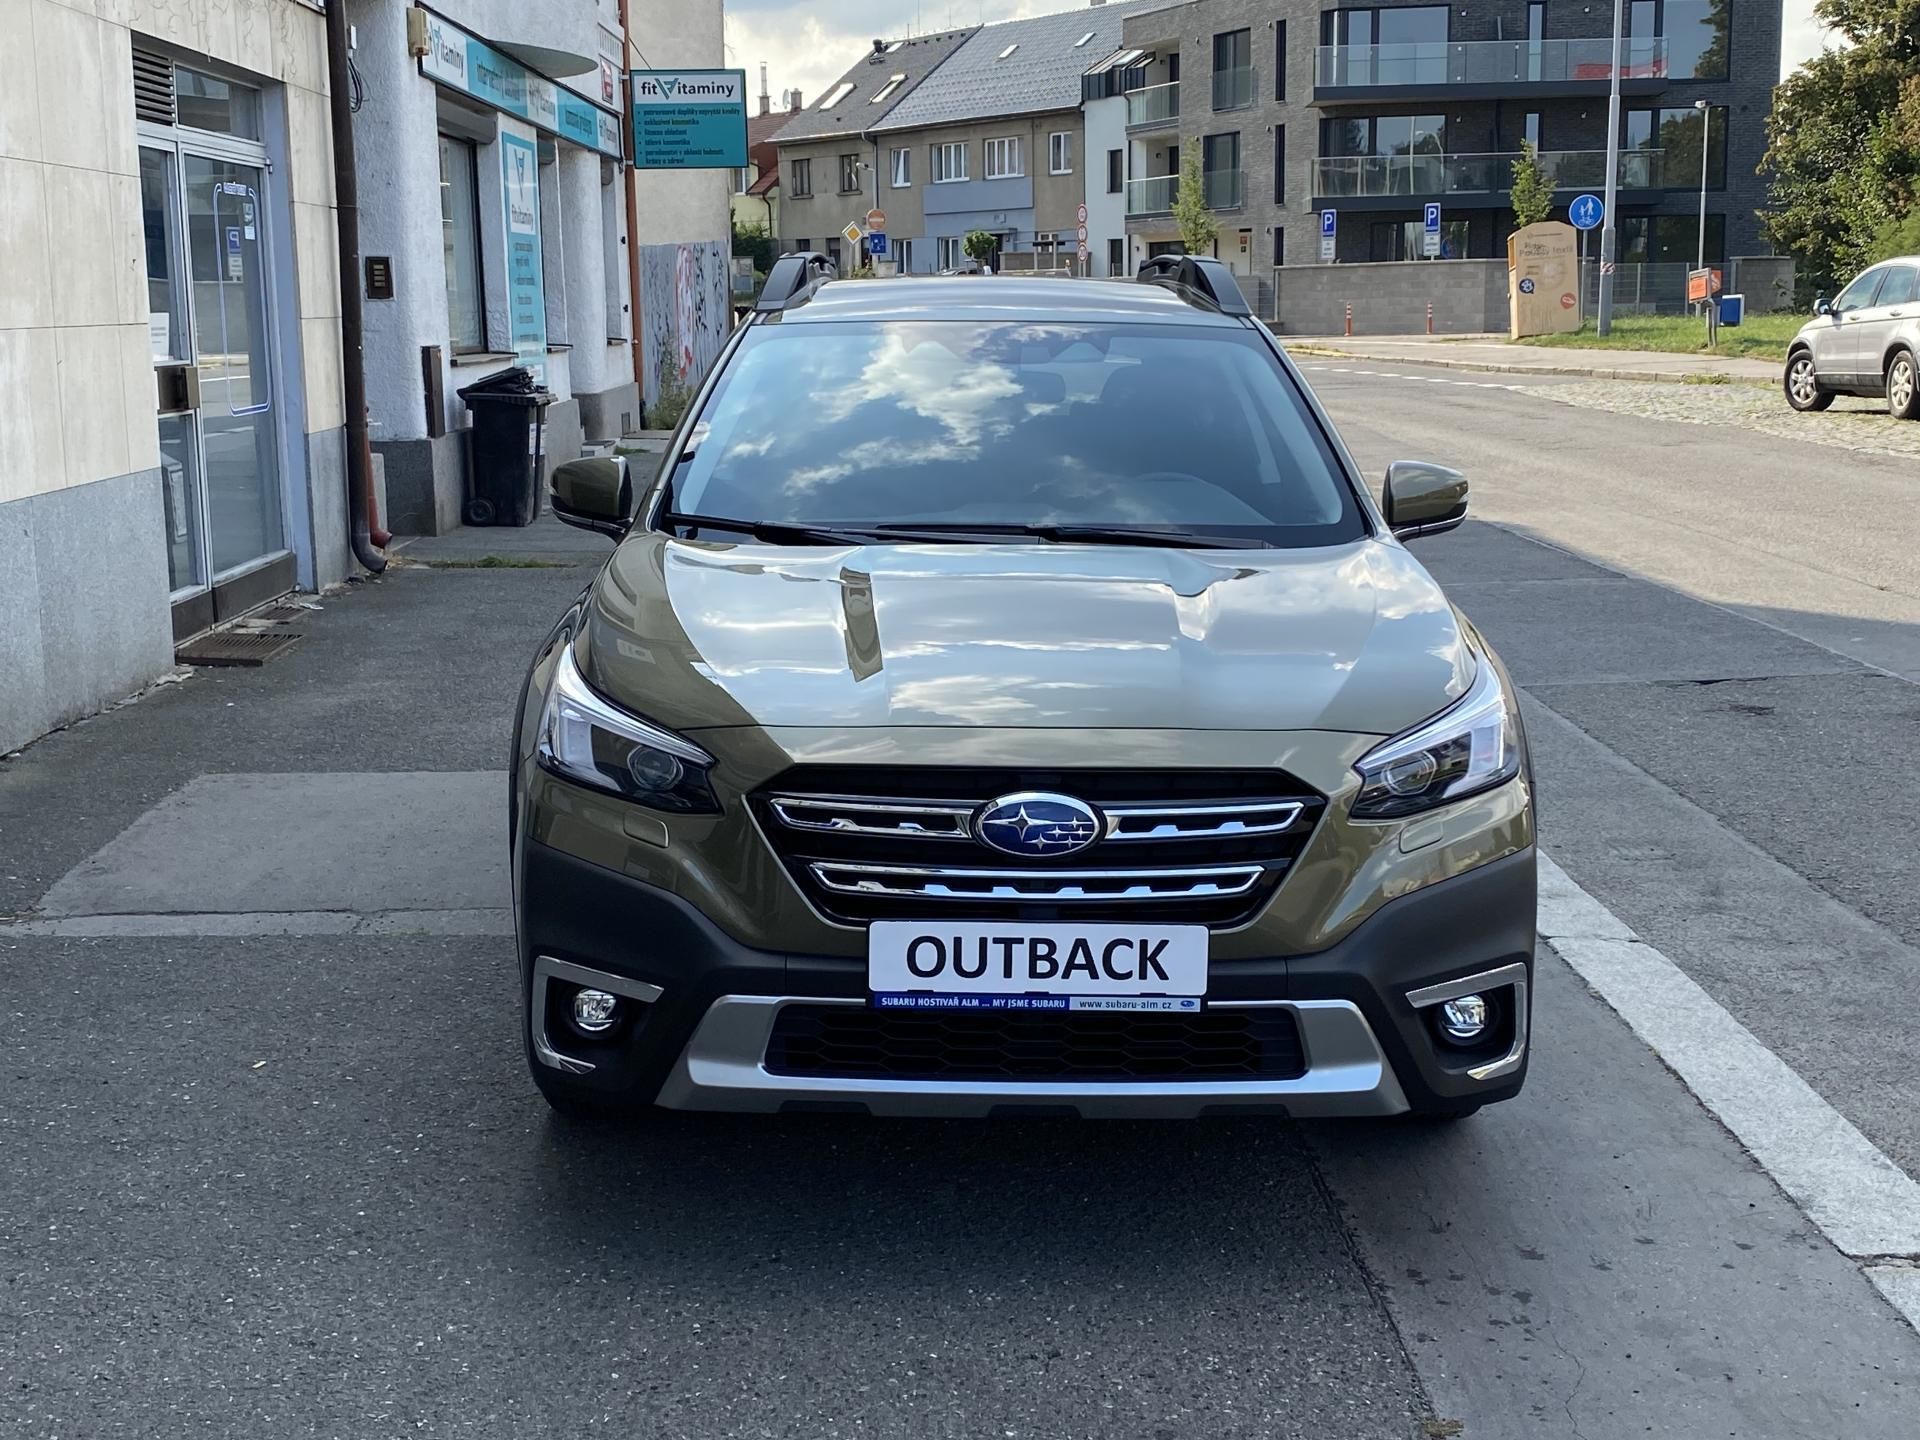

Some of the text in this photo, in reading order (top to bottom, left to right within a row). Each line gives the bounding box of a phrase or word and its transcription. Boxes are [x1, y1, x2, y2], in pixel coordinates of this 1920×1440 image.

[1324, 214, 1333, 230] P
[1428, 207, 1437, 225] P
[906, 935, 1170, 981] OUTBACK
[881, 997, 916, 1006] SUBARU
[917, 996, 959, 1007] HOSTIVAŘ
[961, 998, 979, 1007] ALM
[992, 999, 1006, 1007] MY
[1007, 999, 1029, 1008] JSME
[1031, 999, 1065, 1008] SUBARU
